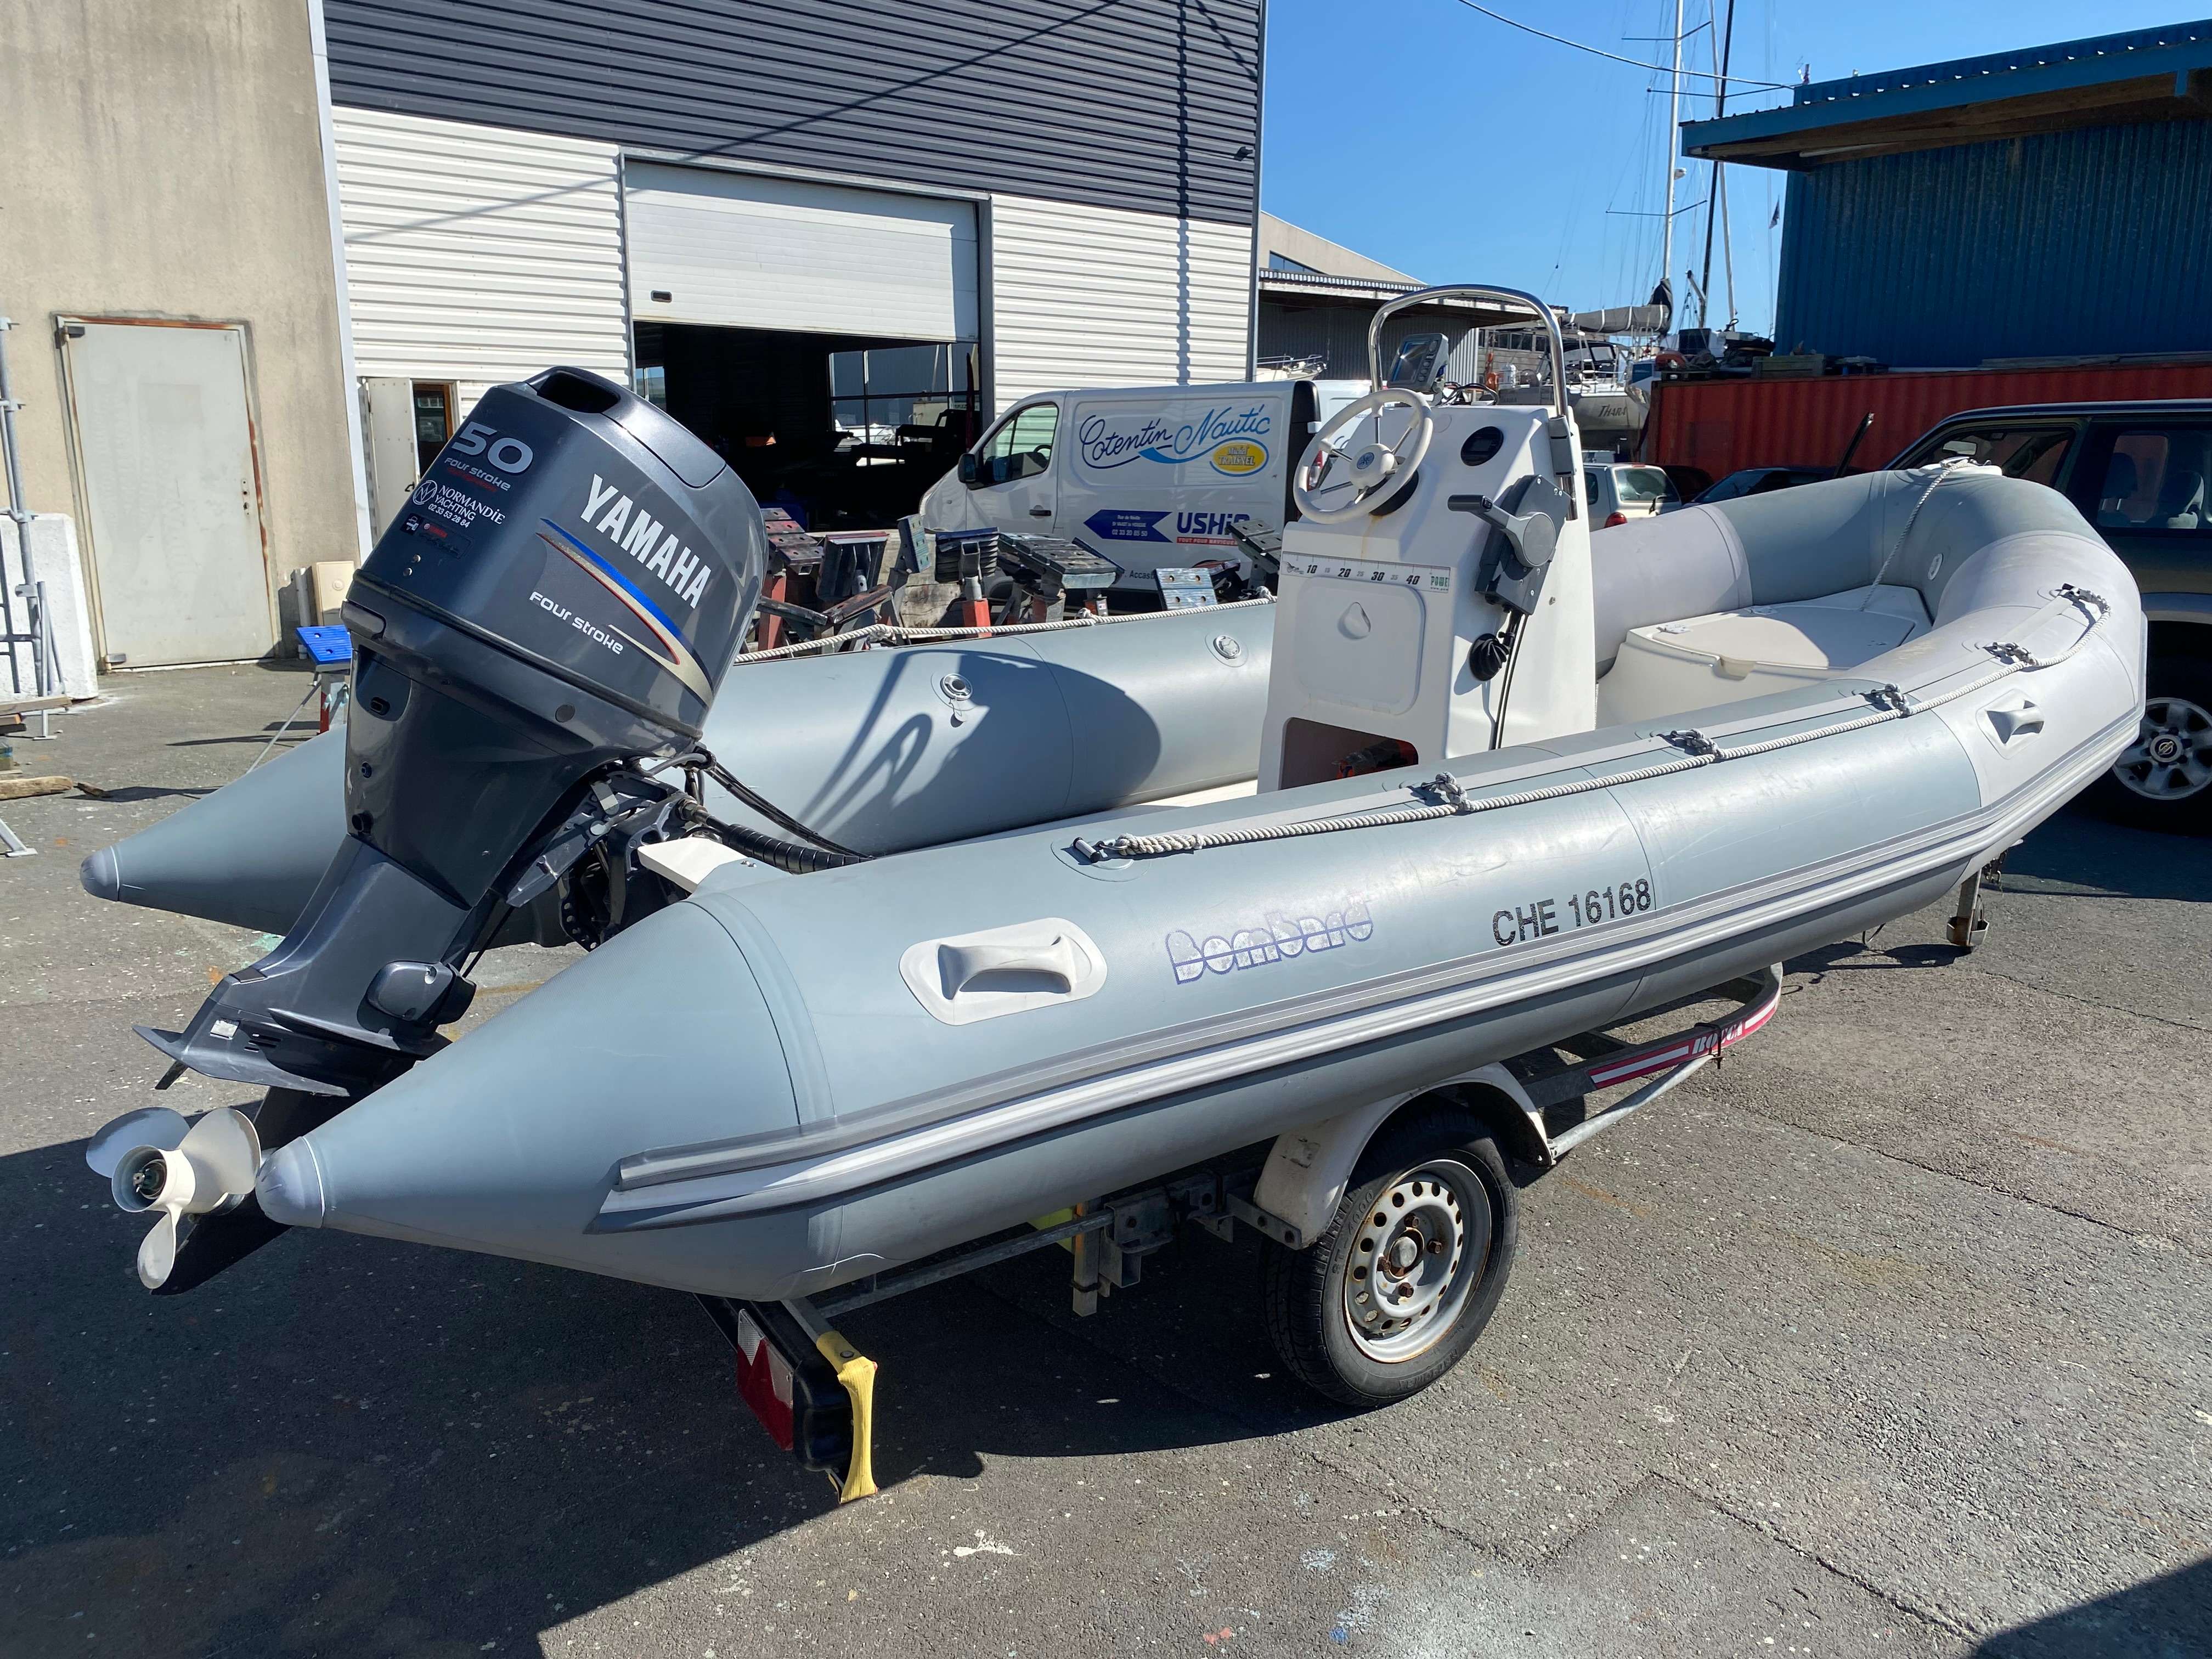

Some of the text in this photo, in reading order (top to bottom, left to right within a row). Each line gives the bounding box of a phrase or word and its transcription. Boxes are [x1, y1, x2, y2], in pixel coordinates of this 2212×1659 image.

[452, 421, 534, 473] 50
[1080, 404, 1270, 469] Cotentin Nautic
[470, 467, 511, 491] stroke
[428, 504, 435, 512] 02
[435, 506, 445, 515] 33
[443, 511, 453, 519] 53
[460, 519, 470, 528] 84
[435, 494, 476, 521] YACHTING
[580, 473, 712, 609] YAMAHA
[1306, 564, 1318, 574] 10
[1338, 567, 1351, 578] 20
[1371, 571, 1385, 581] 30
[1406, 575, 1420, 585] 40
[572, 617, 624, 654] stroke
[1492, 878, 1651, 946] CHE 16168
